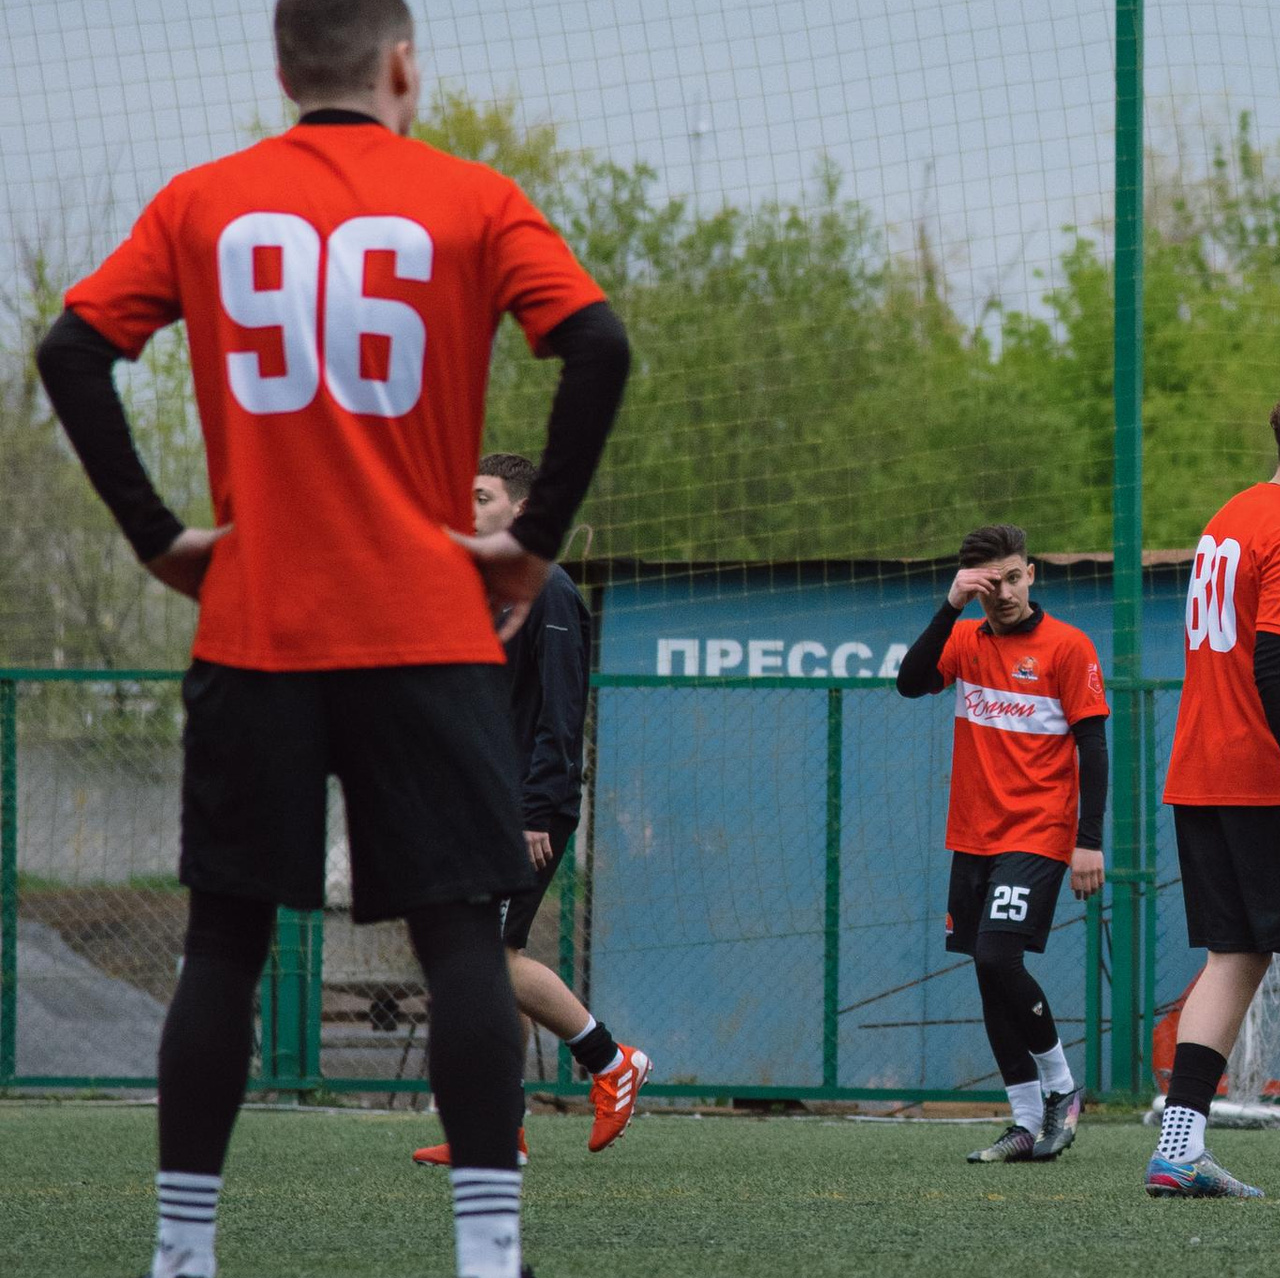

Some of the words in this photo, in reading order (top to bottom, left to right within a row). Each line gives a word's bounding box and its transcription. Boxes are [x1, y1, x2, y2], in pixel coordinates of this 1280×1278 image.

[217, 211, 434, 418] 96
[1185, 534, 1241, 653] 80
[989, 885, 1031, 922] 25
